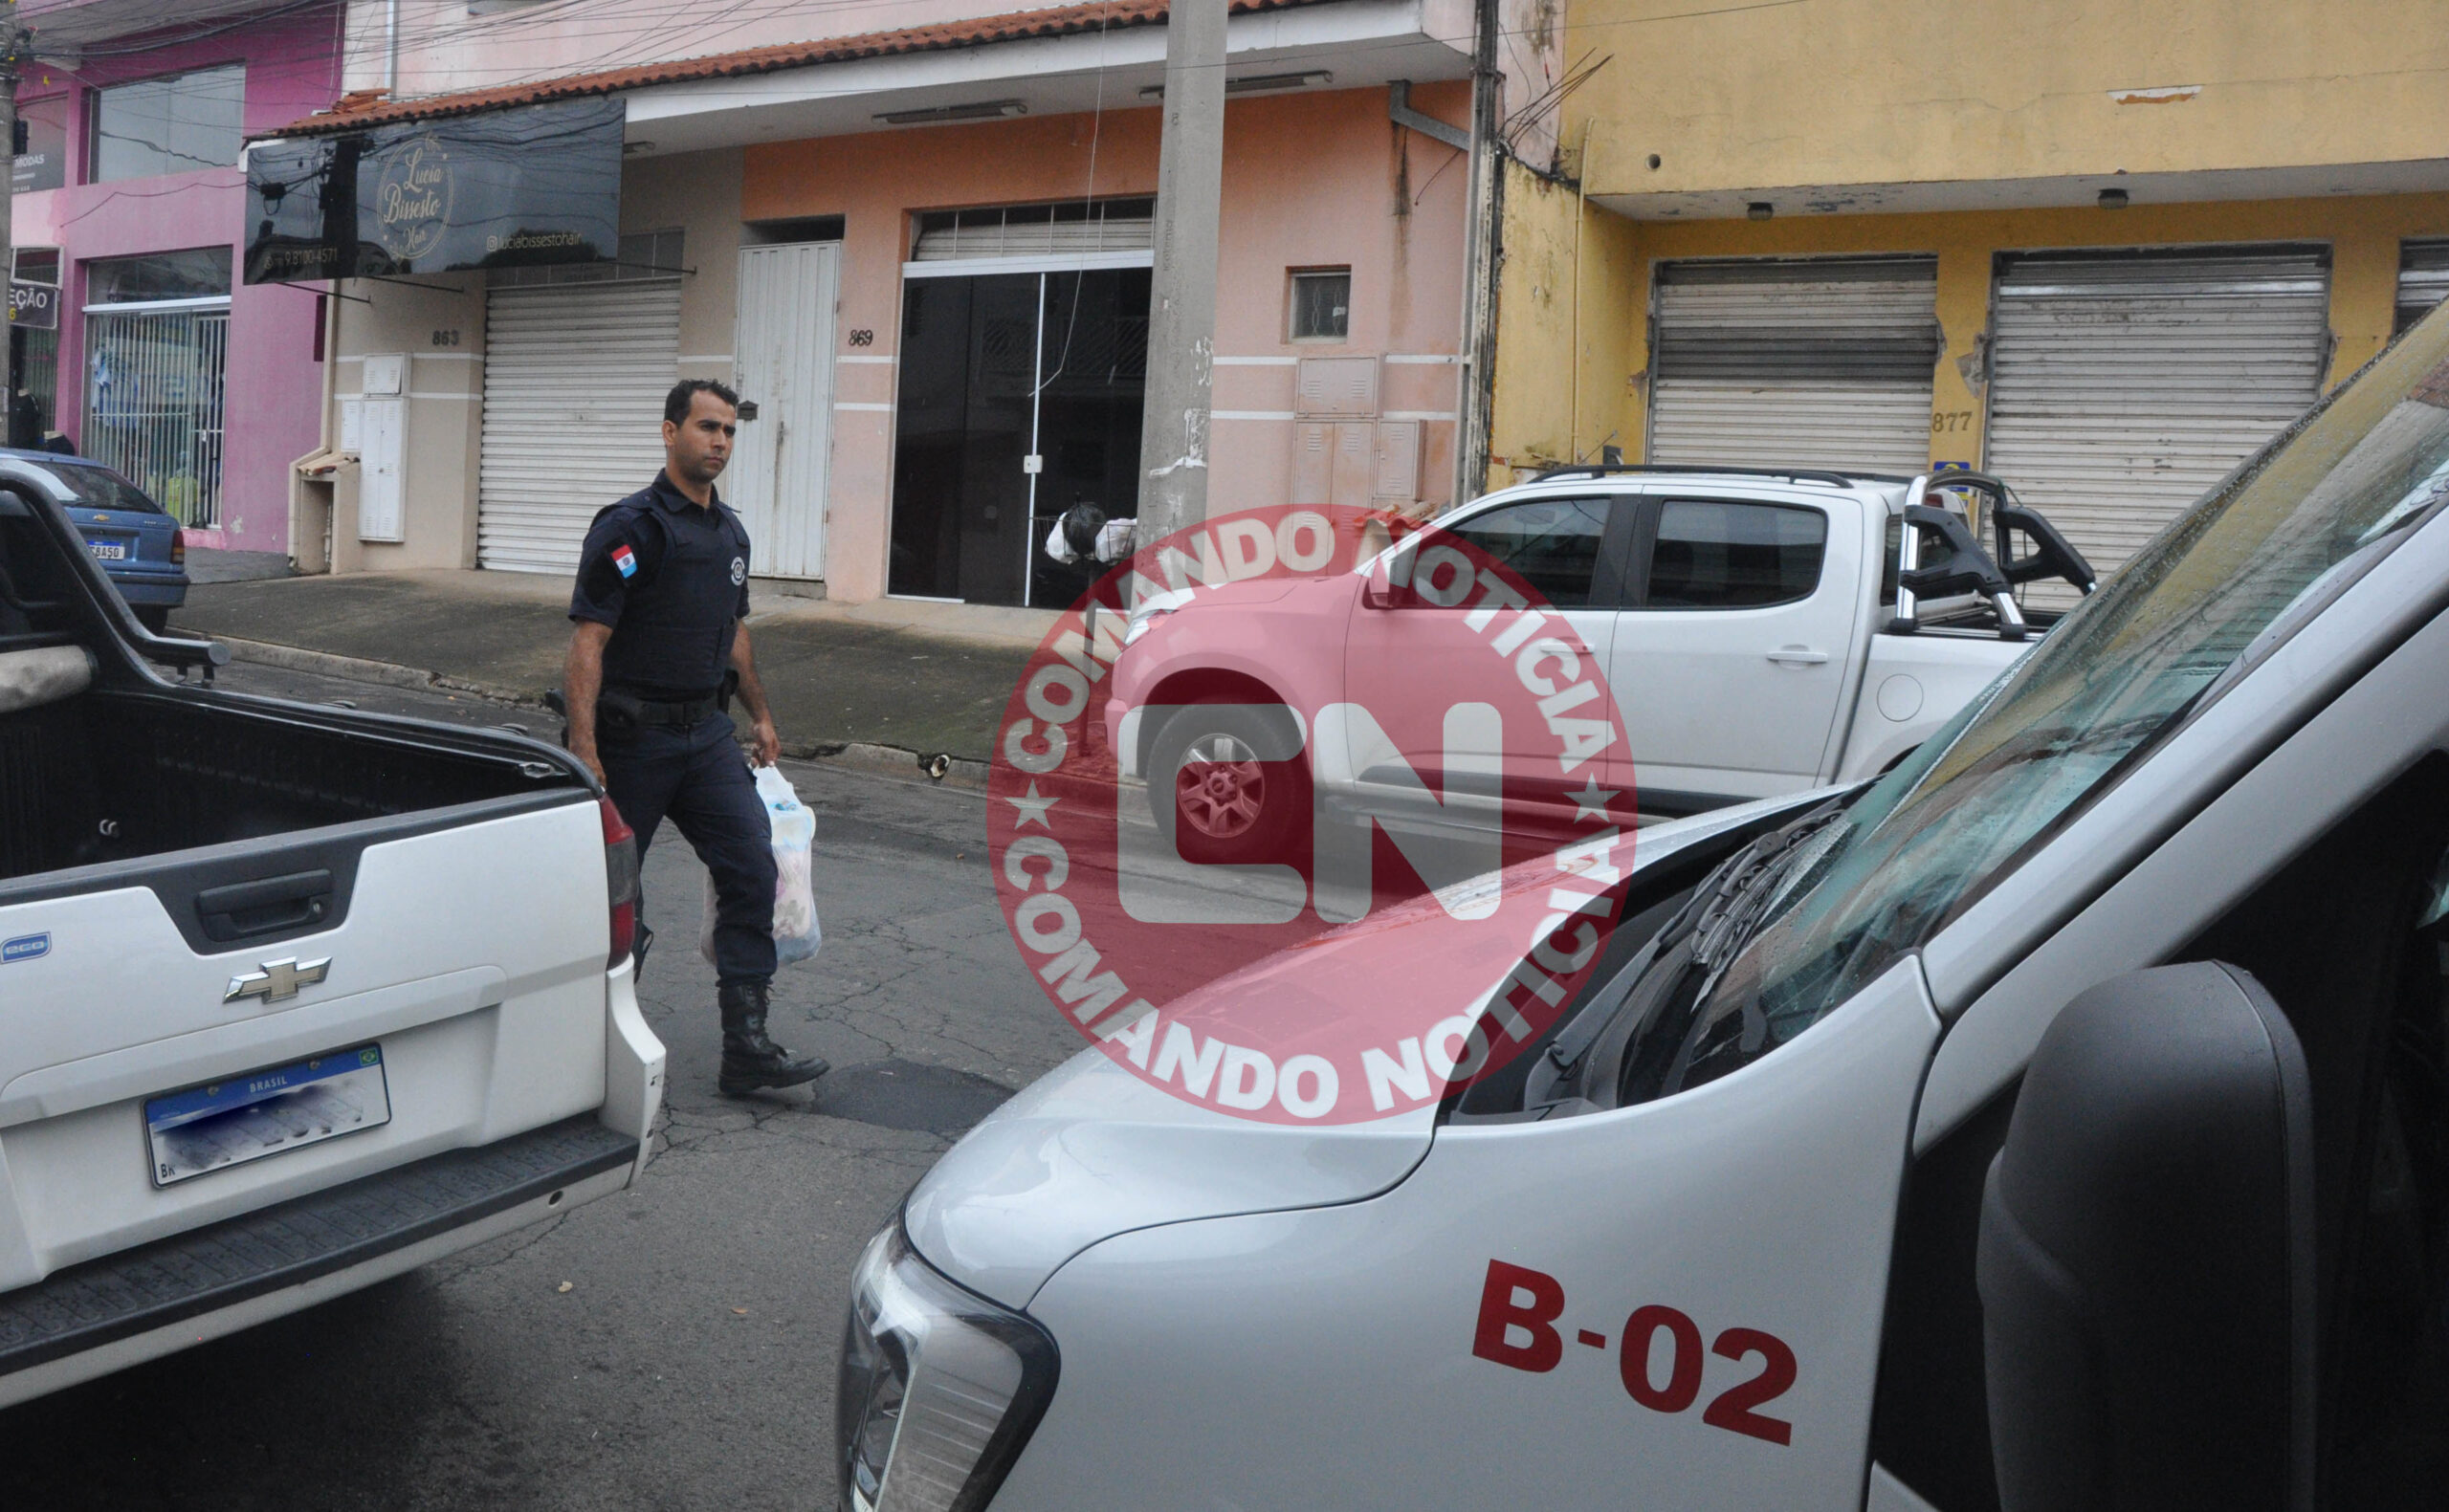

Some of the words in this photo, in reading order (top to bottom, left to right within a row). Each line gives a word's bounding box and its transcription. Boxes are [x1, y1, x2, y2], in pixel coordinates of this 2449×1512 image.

[403, 147, 443, 193] Lucia
[384, 183, 442, 224] Bissesto
[432, 329, 460, 346] 863
[849, 329, 873, 346] 869
[1932, 411, 1973, 433] 877
[6, 941, 45, 955] eco
[249, 1076, 289, 1093] BRASIL
[1471, 1258, 1798, 1447] B-02
